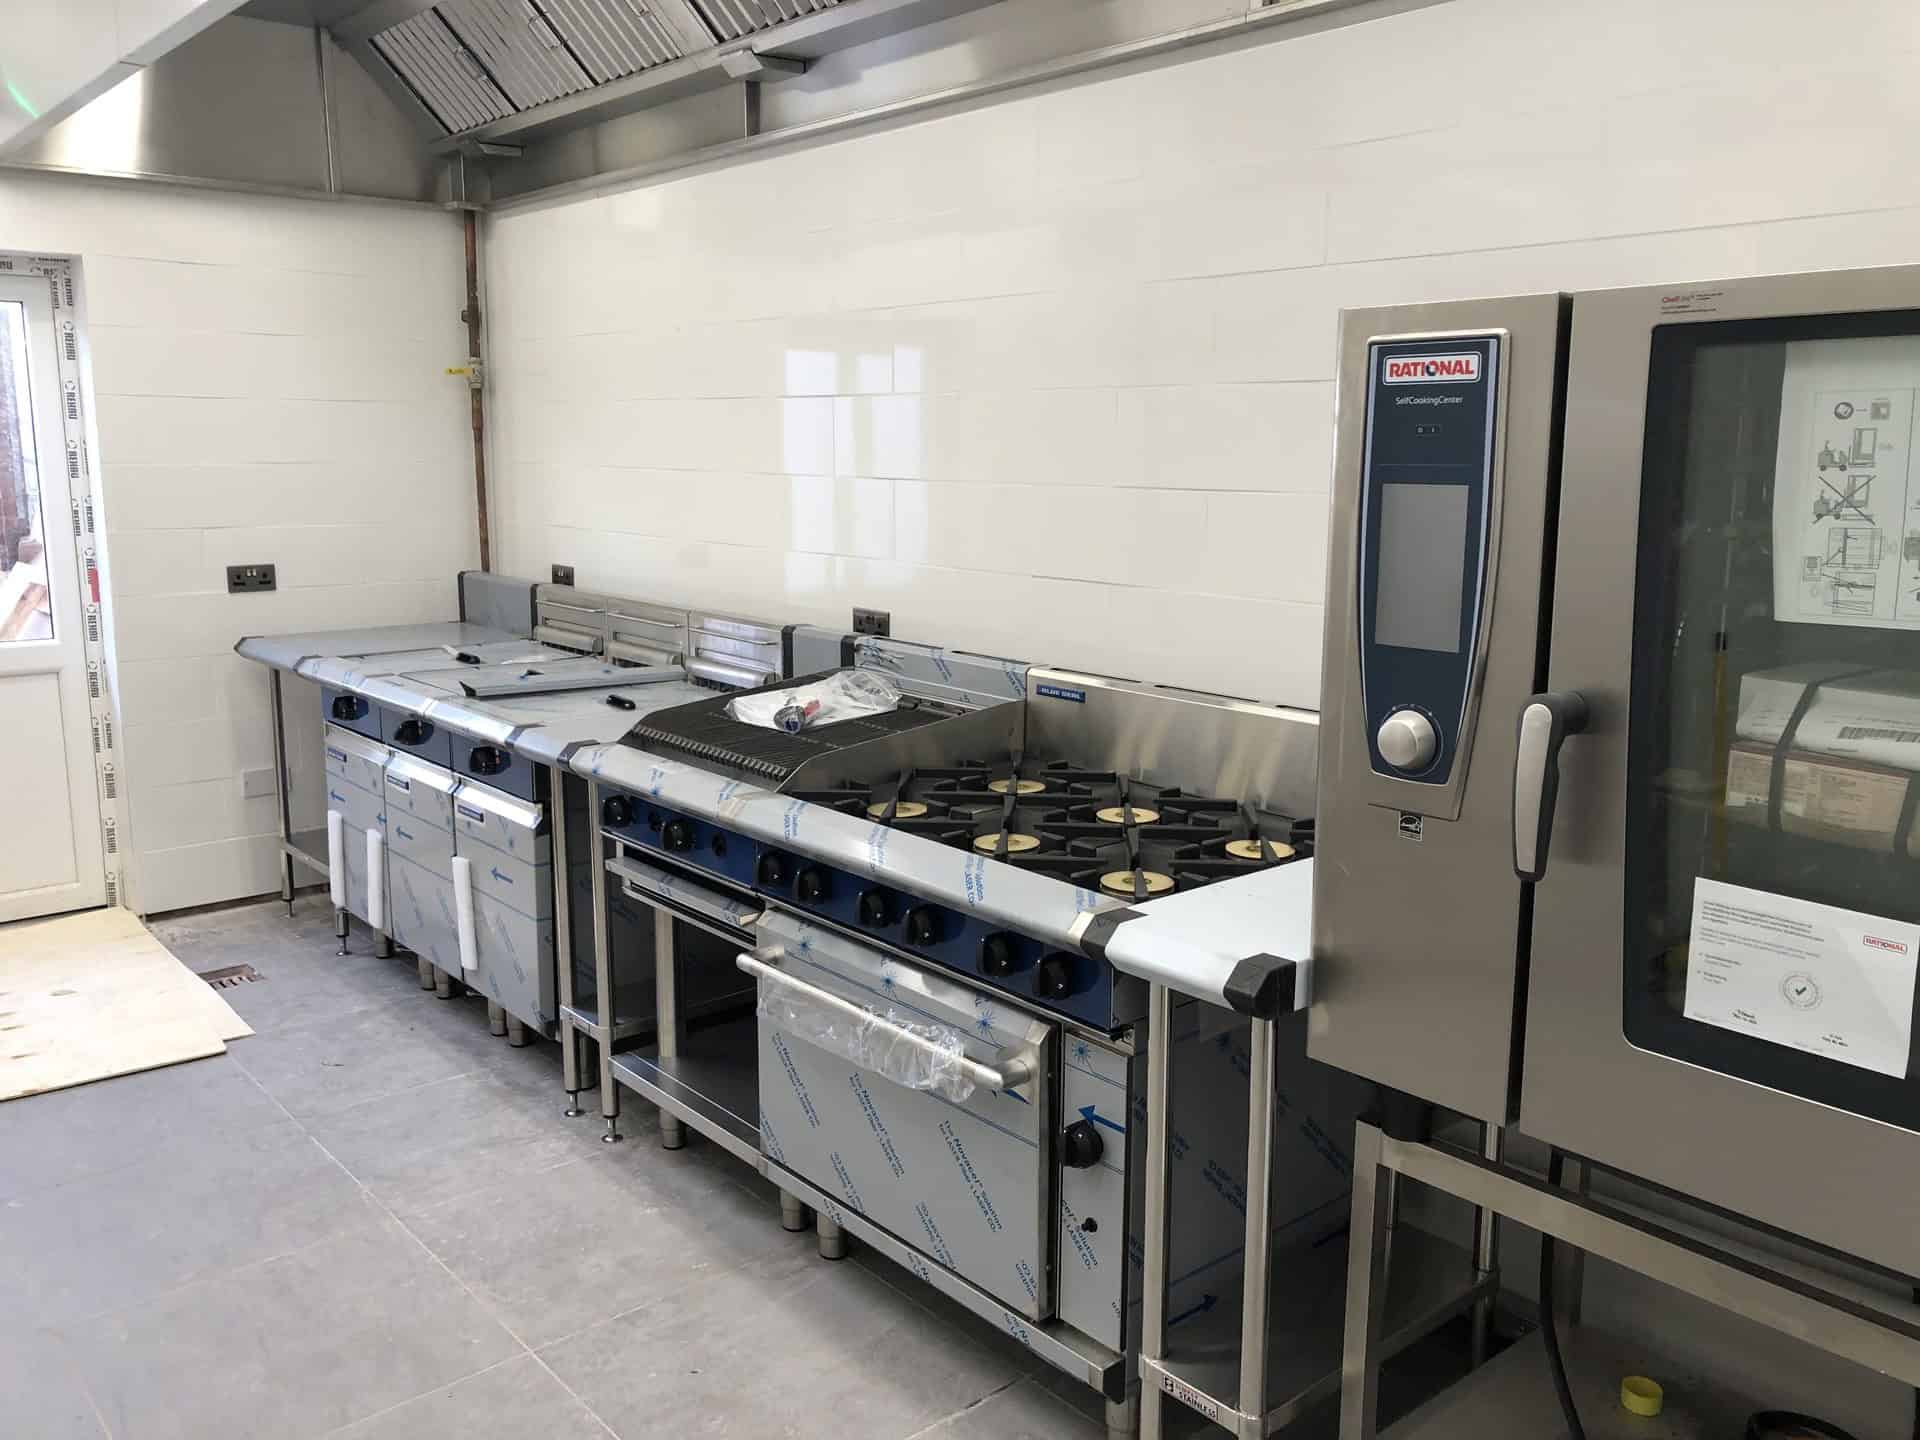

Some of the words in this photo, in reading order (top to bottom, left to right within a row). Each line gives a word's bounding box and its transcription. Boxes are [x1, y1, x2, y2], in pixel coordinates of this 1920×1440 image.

[64, 332, 76, 360] REHAU
[1389, 360, 1474, 378] RATIONAL
[67, 392, 78, 419] REHAU
[1395, 396, 1464, 407] SelfCookingCenter
[68, 451, 80, 478] REHAU
[87, 615, 98, 641] REHAU
[89, 672, 99, 697] REHAU
[104, 773, 116, 799] REHAU
[106, 828, 117, 853] REHAU
[1179, 1391, 1217, 1418] STAINLESS
